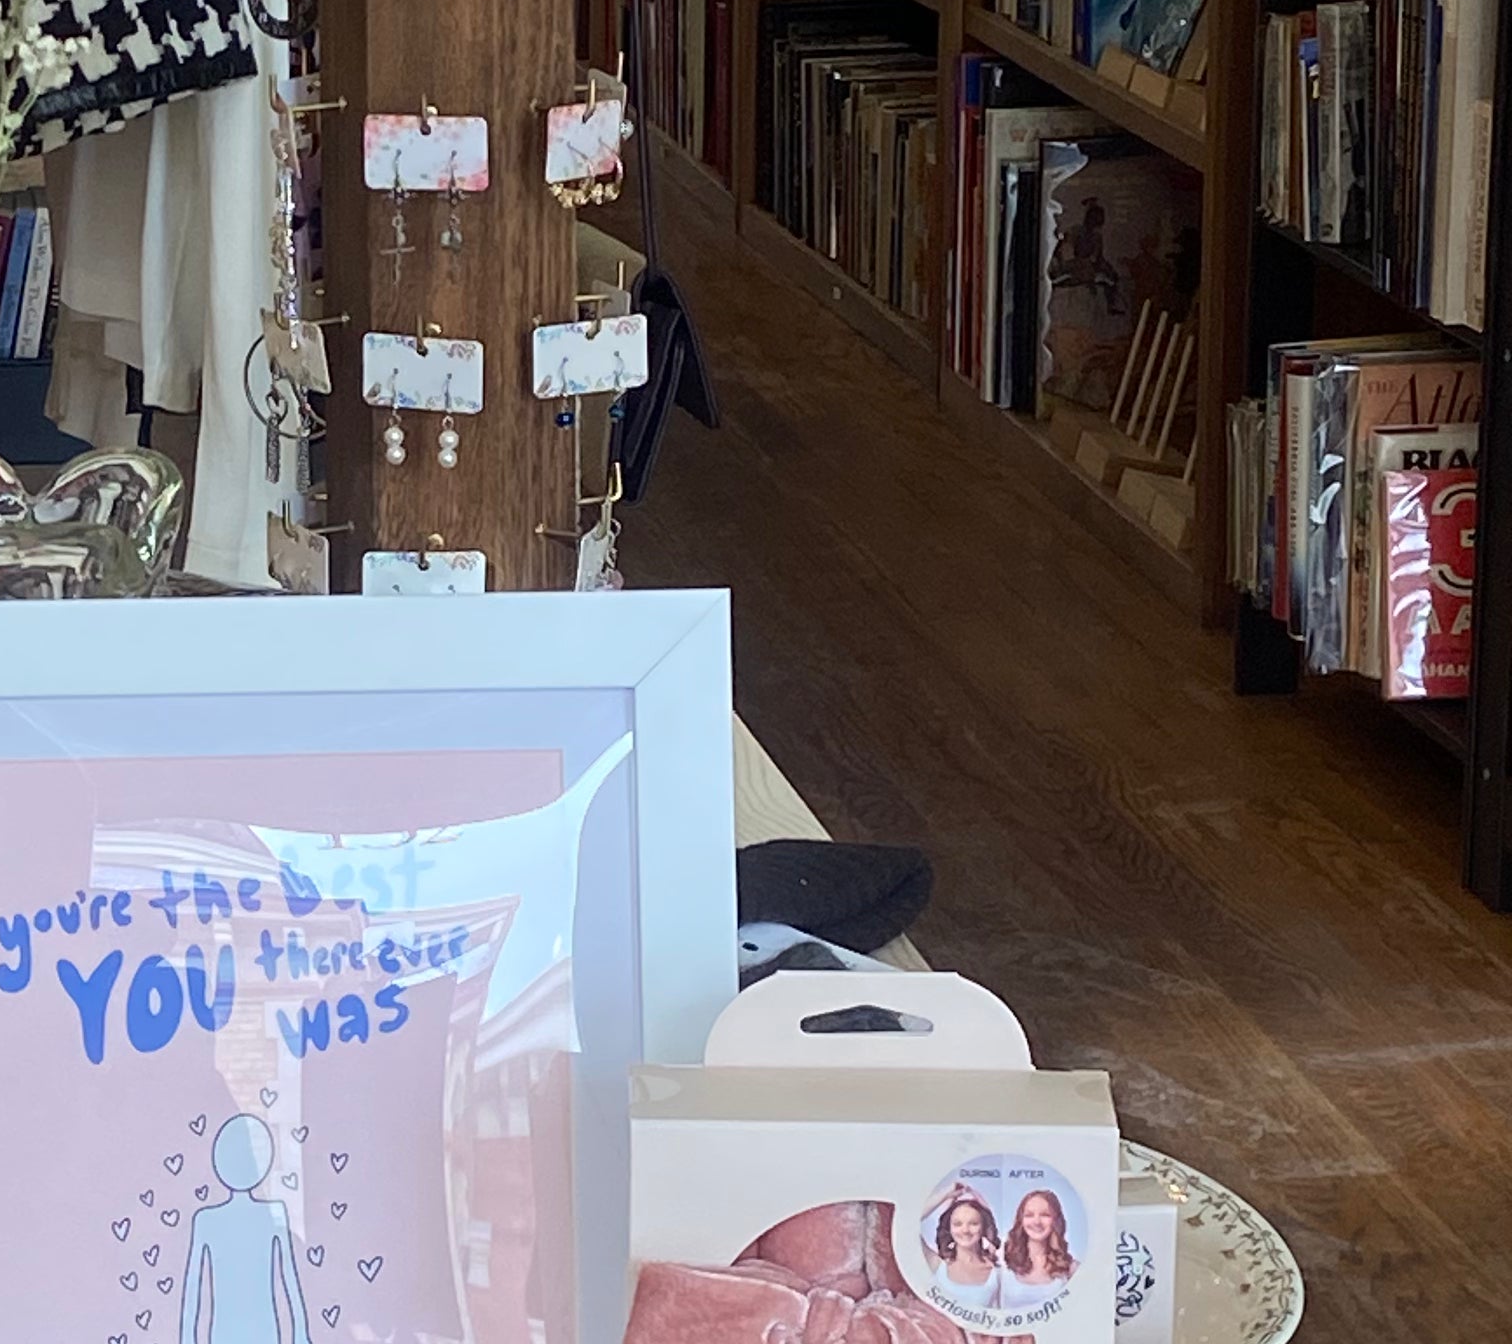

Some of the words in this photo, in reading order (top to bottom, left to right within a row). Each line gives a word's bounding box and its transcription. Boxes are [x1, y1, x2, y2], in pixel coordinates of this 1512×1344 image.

[149, 869, 262, 928] the
[255, 929, 365, 981] there
[379, 925, 470, 974] ever
[56, 944, 236, 1065] YOU
[276, 984, 409, 1059] was
[1009, 1168, 1045, 1179] AFTER
[1004, 1314, 1024, 1327] so
